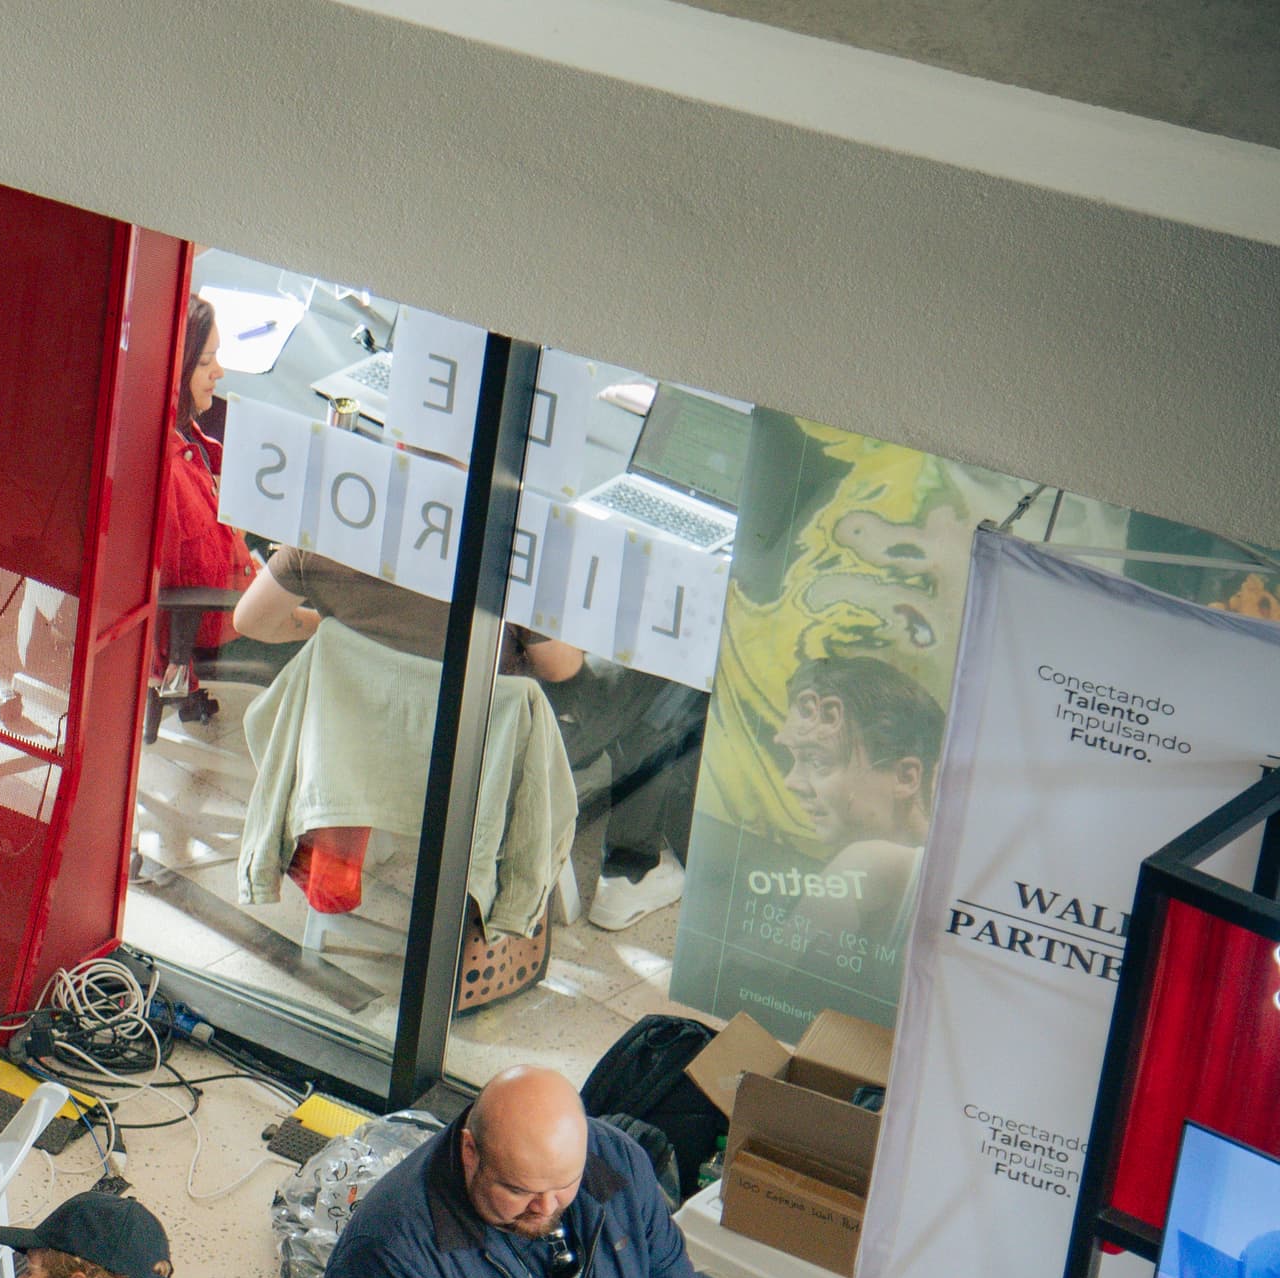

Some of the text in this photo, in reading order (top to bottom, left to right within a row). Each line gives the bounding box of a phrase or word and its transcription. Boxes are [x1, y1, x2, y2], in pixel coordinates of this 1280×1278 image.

[1037, 664, 1176, 718] Conectando
[1064, 689, 1150, 726] Talento
[1055, 702, 1193, 756] Impulsando
[1071, 726, 1153, 764] Futuro.
[945, 908, 1124, 983] PARTNE
[980, 1139, 1080, 1183] Impulsan
[988, 1126, 1070, 1164] Talento
[994, 1163, 1072, 1199] Futuro.
